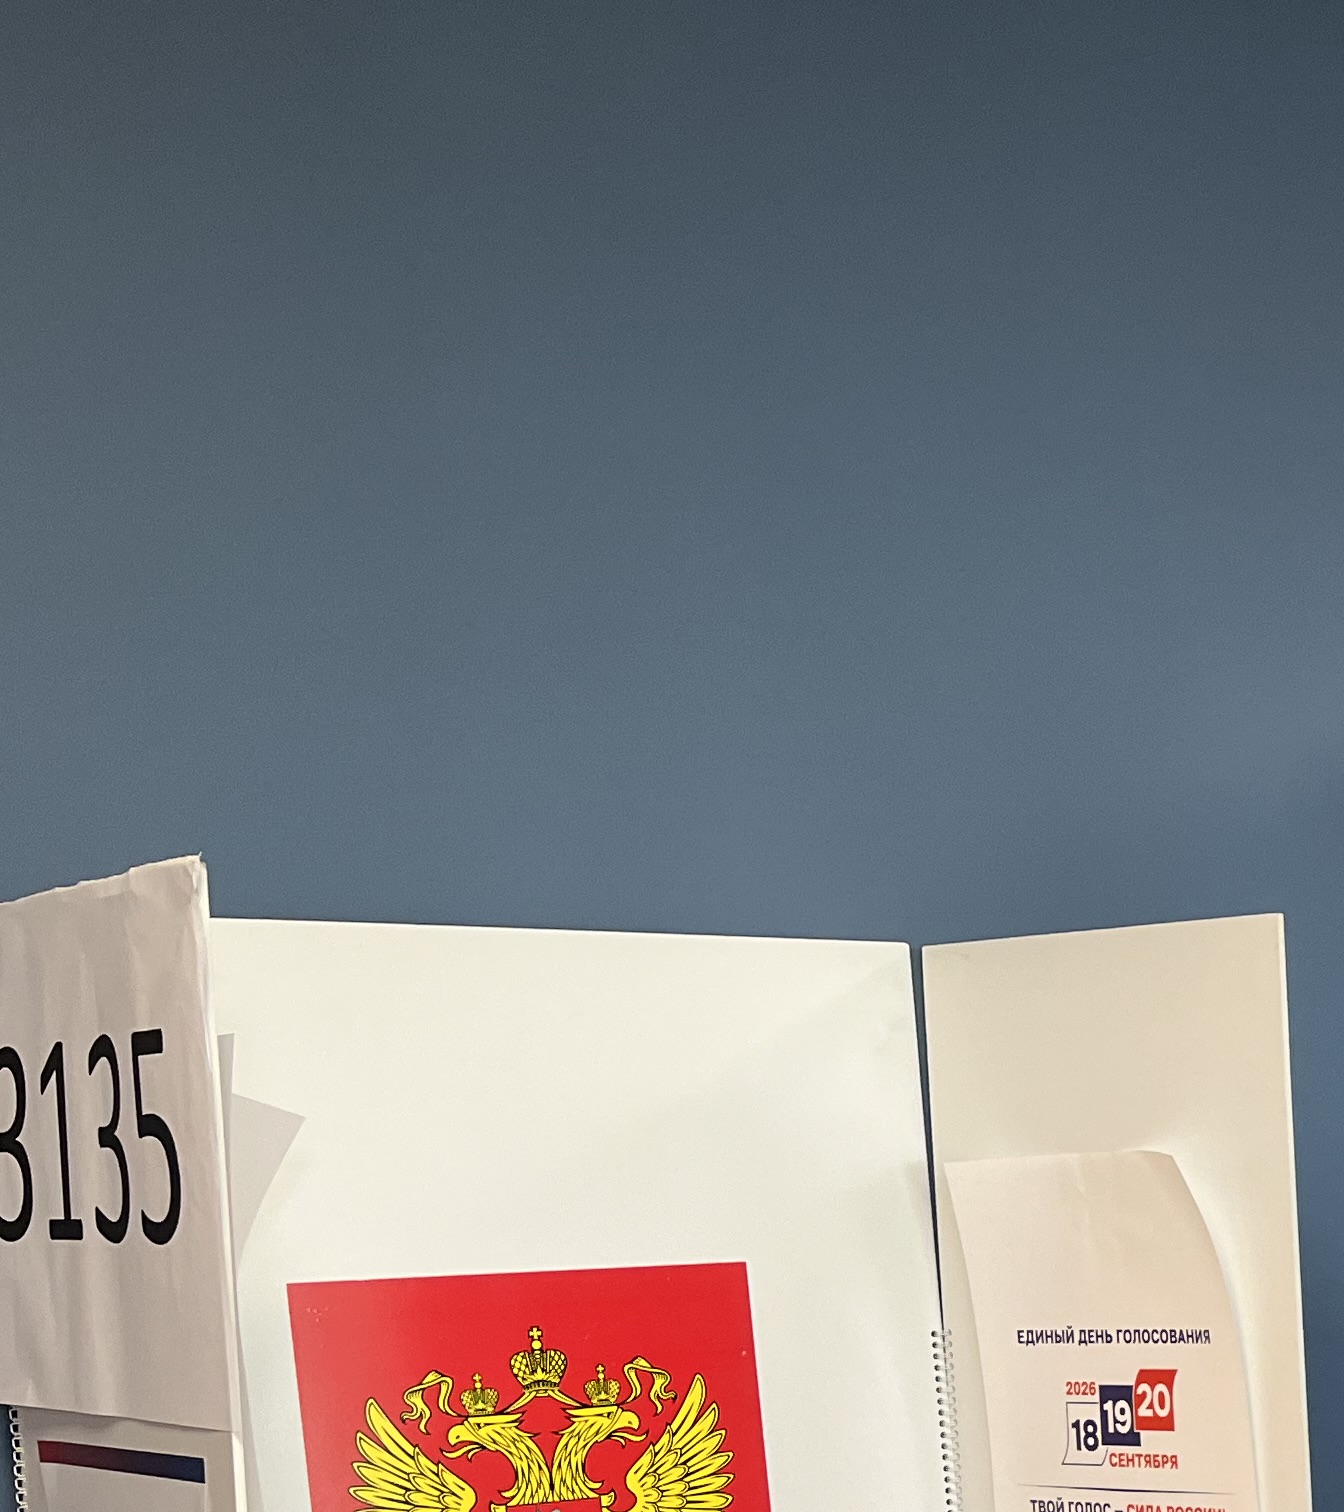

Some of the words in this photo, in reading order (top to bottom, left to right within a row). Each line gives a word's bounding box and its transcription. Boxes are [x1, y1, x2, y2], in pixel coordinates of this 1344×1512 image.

[1016, 1325, 1075, 1346] ЕДИНЫЙ
[1078, 1329, 1113, 1346] ДЕНЬ
[1116, 1329, 1211, 1345] ГОЛОСОВАНИЯ
[1065, 1381, 1097, 1396] 2026
[1135, 1382, 1172, 1418] 20
[1102, 1399, 1133, 1435] 19
[1071, 1418, 1100, 1452] 18
[1108, 1452, 1179, 1470] СЕНТЯБРЯ
